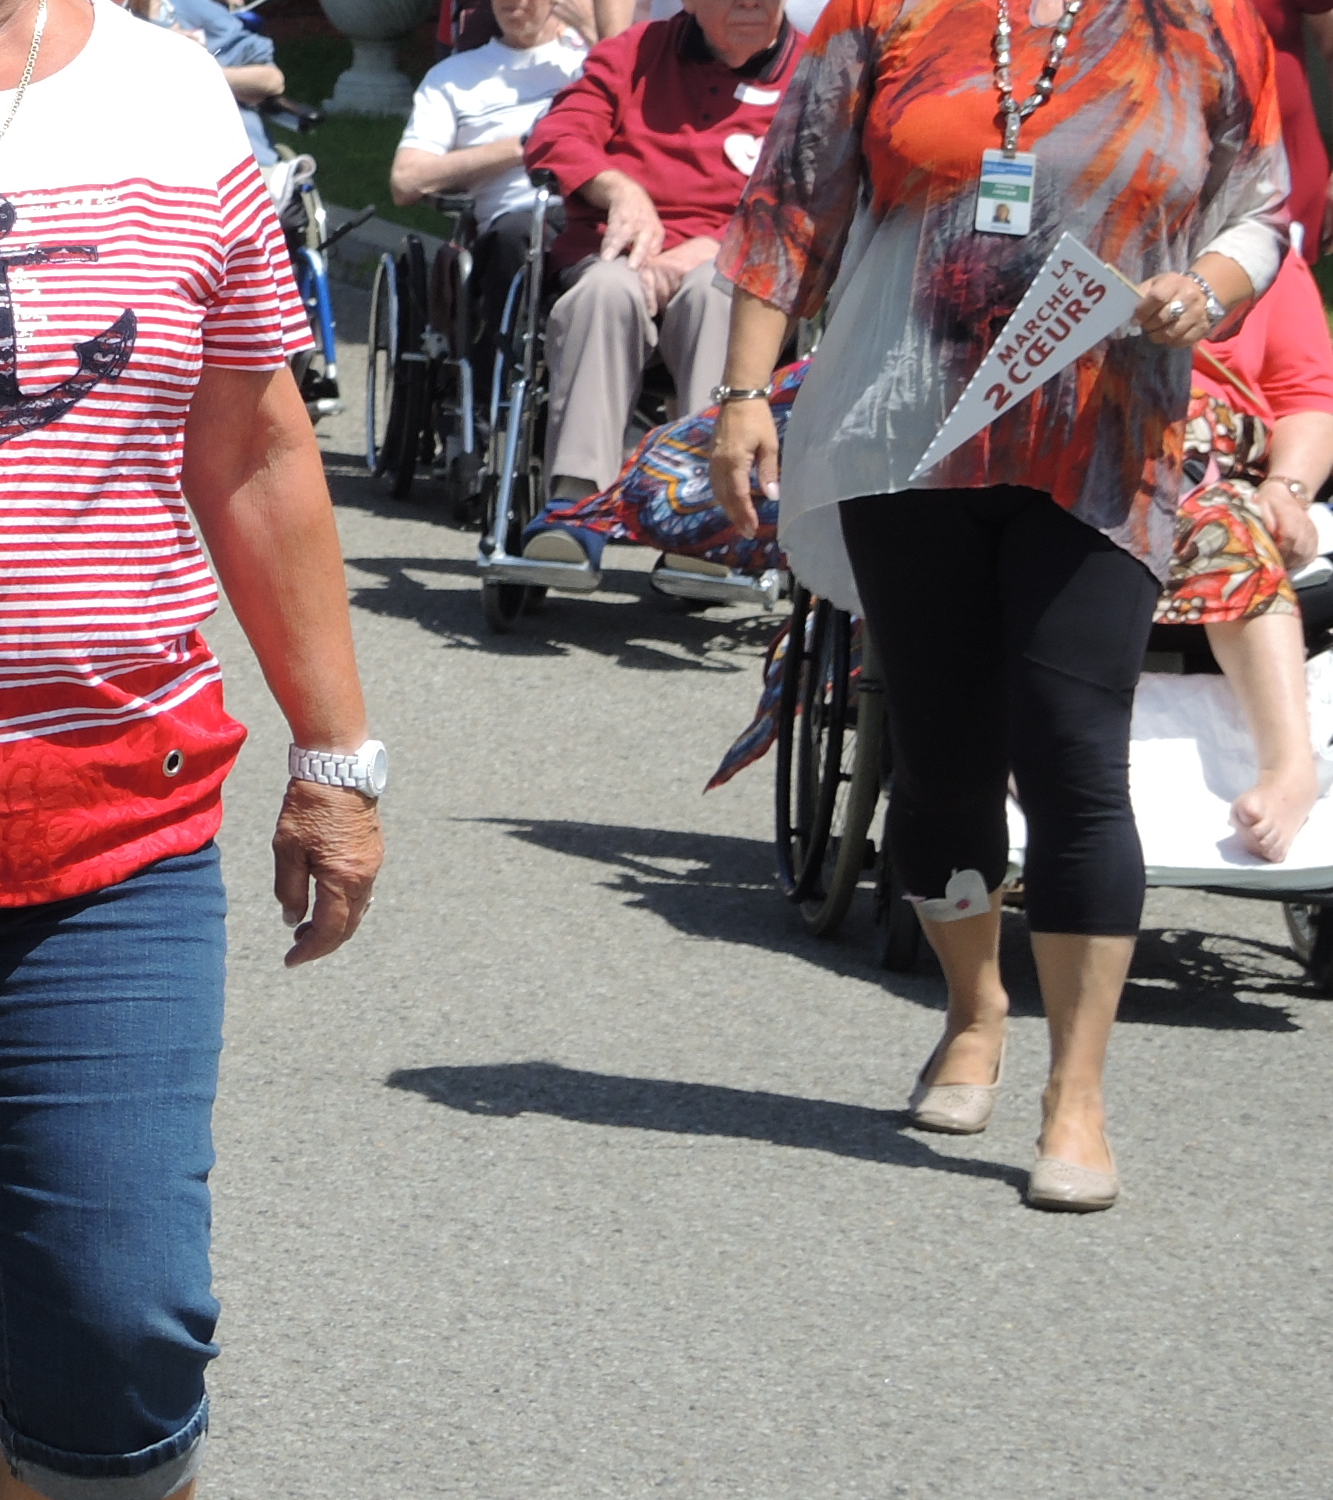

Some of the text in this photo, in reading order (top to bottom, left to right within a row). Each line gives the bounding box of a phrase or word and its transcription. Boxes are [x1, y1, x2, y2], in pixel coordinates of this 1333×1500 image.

[996, 268, 1088, 366] MARCHE À
[1051, 259, 1074, 279] LA
[984, 279, 1106, 411] 2 CŒURS
